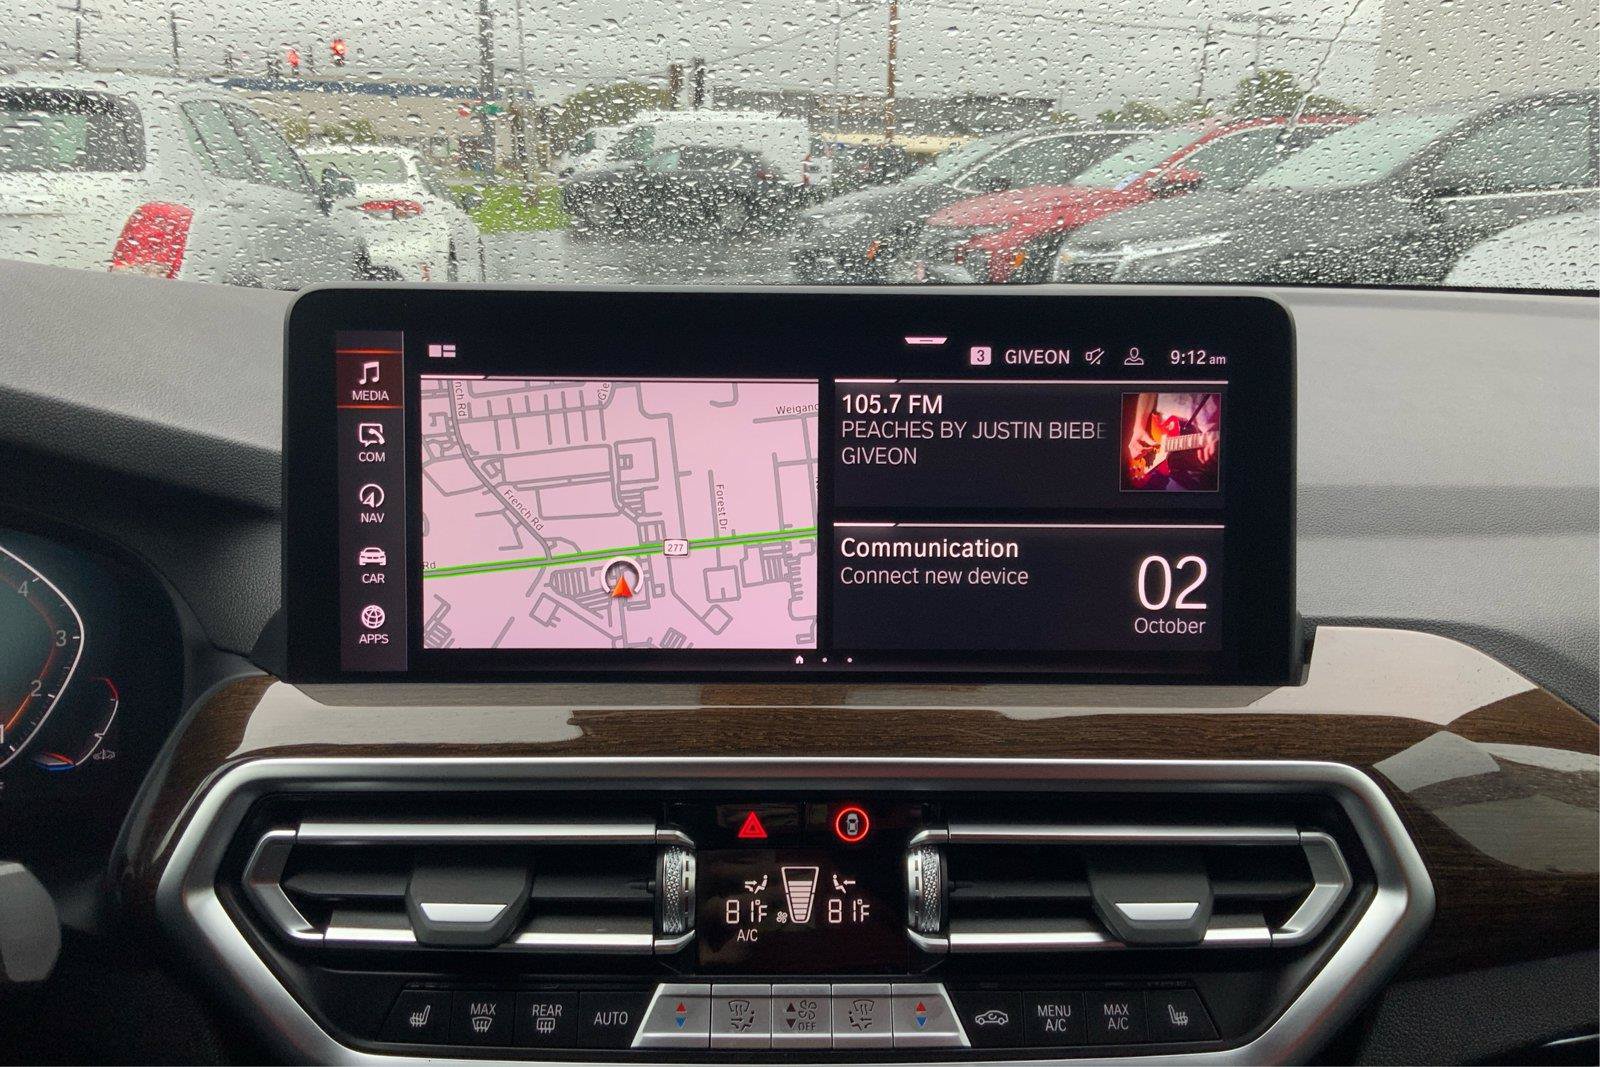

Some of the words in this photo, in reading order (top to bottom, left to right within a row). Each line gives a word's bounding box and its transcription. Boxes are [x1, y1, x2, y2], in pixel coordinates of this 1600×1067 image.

[1005, 349, 1071, 365] GIVEON
[1170, 349, 1206, 365] 9:12
[1208, 356, 1227, 365] am
[352, 390, 390, 401] MEDIA
[842, 394, 902, 414] 105.7
[909, 394, 944, 414] FM
[841, 420, 934, 439] PEACHES
[941, 421, 967, 439] BY
[972, 421, 1043, 440] JUSTIN
[358, 451, 386, 463] COM
[841, 446, 918, 465] GIVEON
[716, 484, 727, 516] Forest
[504, 489, 532, 519] French
[531, 516, 545, 531] Rd
[360, 512, 385, 524] NAV
[719, 518, 728, 531] Dr
[667, 543, 684, 553] 277
[840, 537, 1019, 558] Communication
[361, 573, 386, 584] CAR
[840, 566, 920, 585] Connect
[924, 570, 963, 585] new
[967, 566, 1030, 585] device
[1137, 555, 1208, 611] 02
[17, 580, 29, 598] 4
[1134, 617, 1207, 635] October
[55, 629, 67, 647] 3
[358, 631, 390, 645] APPS
[30, 679, 42, 698] 2
[736, 928, 758, 943] A/C
[470, 1003, 497, 1016] MAX
[531, 1003, 563, 1018] REAR
[1037, 1003, 1072, 1018] MENU
[1103, 1003, 1130, 1016] MAX
[593, 1011, 629, 1026] AUTO
[1044, 1018, 1067, 1032] A/C
[1107, 1016, 1129, 1031] A/C
[798, 1022, 817, 1031] OFF
